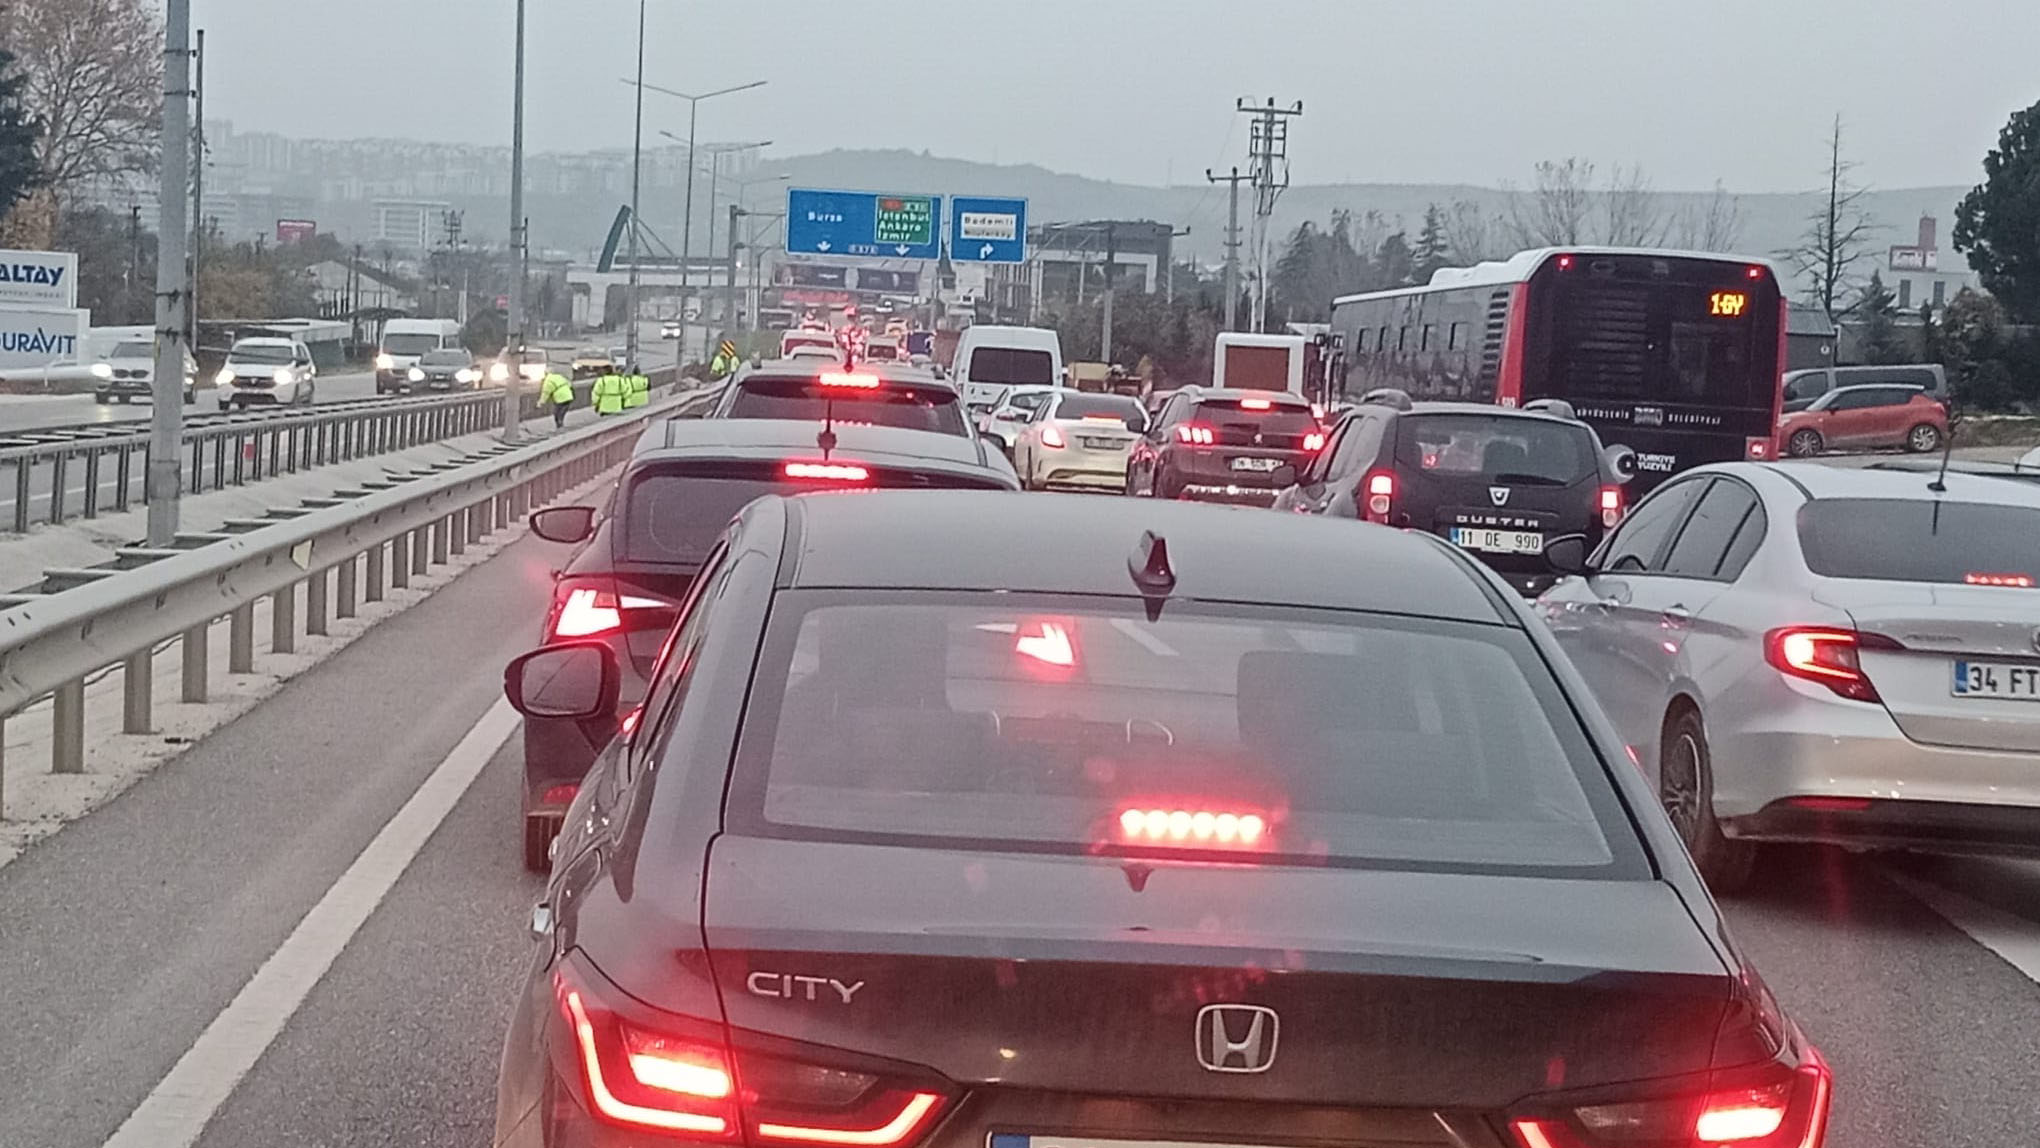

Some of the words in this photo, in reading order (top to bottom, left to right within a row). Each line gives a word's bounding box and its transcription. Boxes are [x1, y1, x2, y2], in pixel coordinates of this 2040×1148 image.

[808, 211, 842, 222] Bursa
[879, 220, 921, 232] Ankara
[0, 328, 76, 354] URAVIT
[1456, 515, 1539, 527] DUSTER
[1461, 530, 1473, 545] 11
[1485, 532, 1502, 547] DE
[1515, 534, 1540, 550] 990
[1969, 666, 1998, 692] 34
[2010, 668, 2040, 694] FT
[747, 971, 864, 1003] CITY
